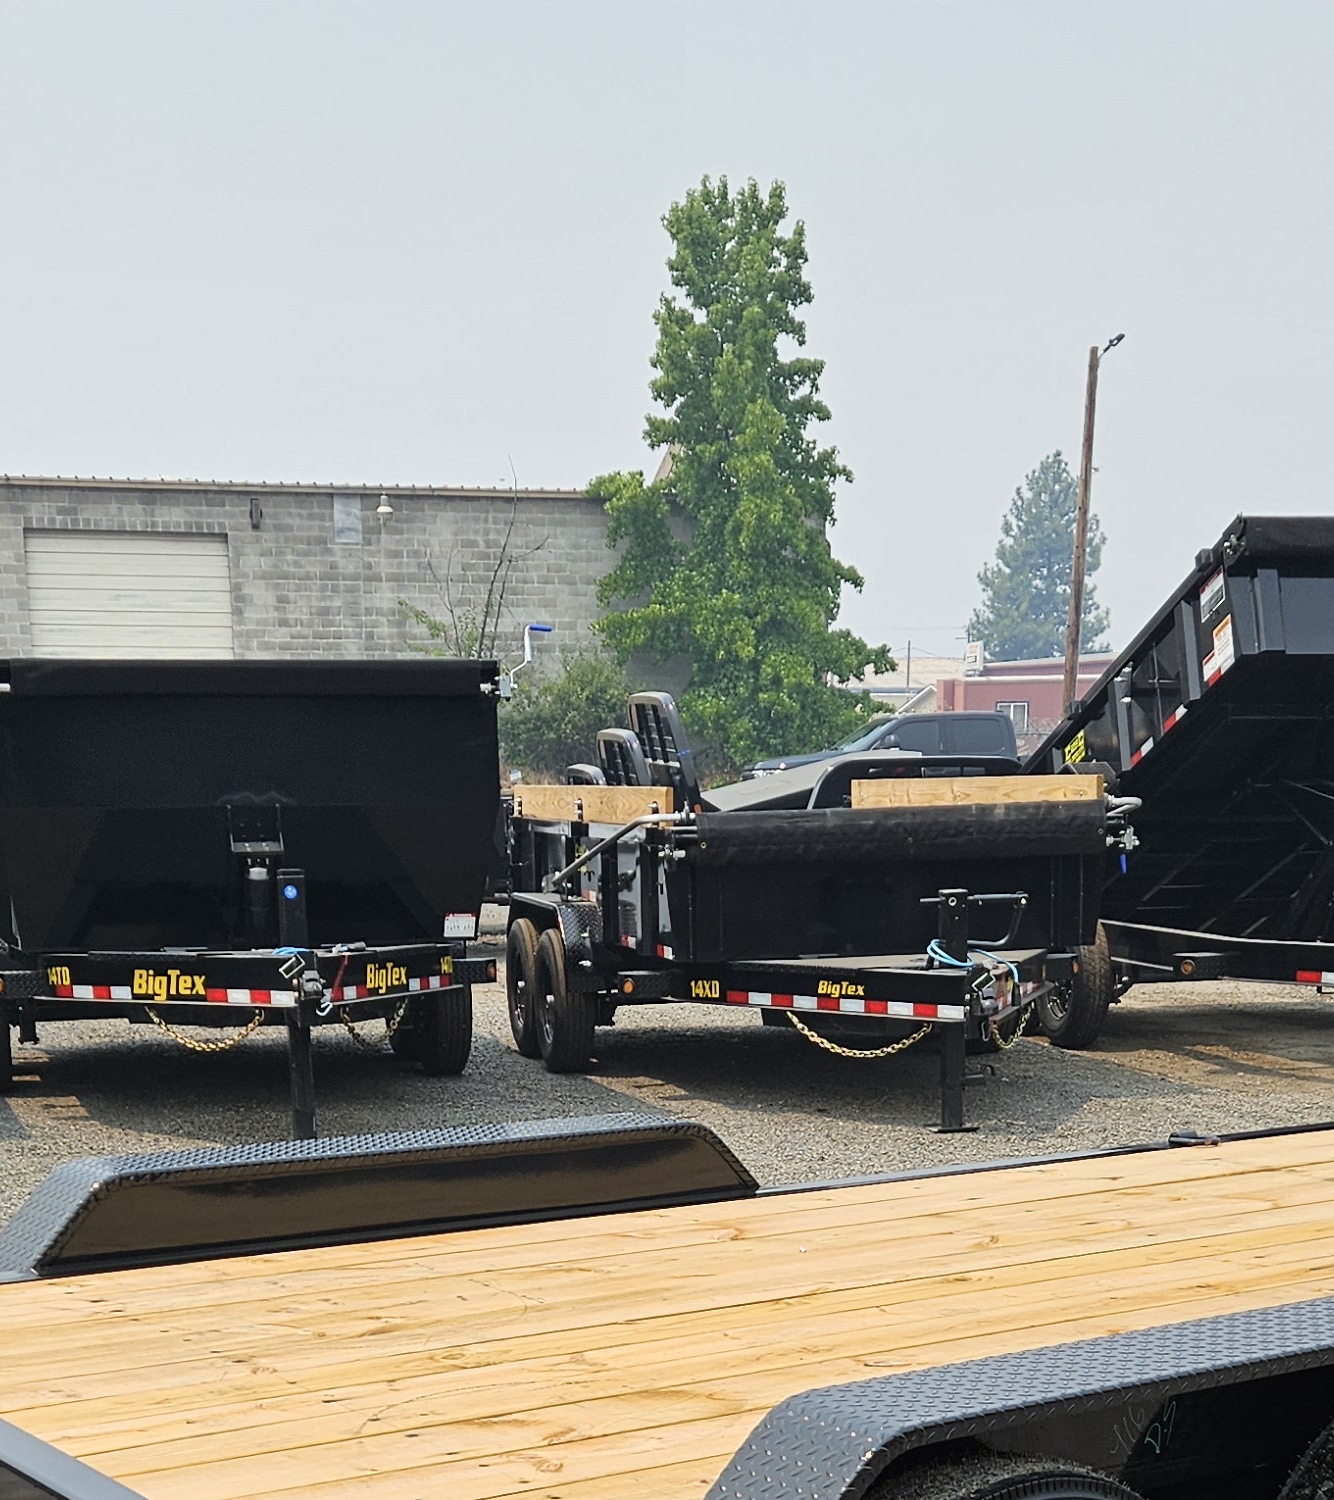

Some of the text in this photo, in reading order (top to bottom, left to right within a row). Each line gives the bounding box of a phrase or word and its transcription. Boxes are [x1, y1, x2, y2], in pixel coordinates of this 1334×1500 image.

[133, 968, 207, 1001] BigTex
[366, 962, 407, 994] BigTex
[690, 980, 720, 998] 14XD
[817, 979, 865, 998] BigTex
